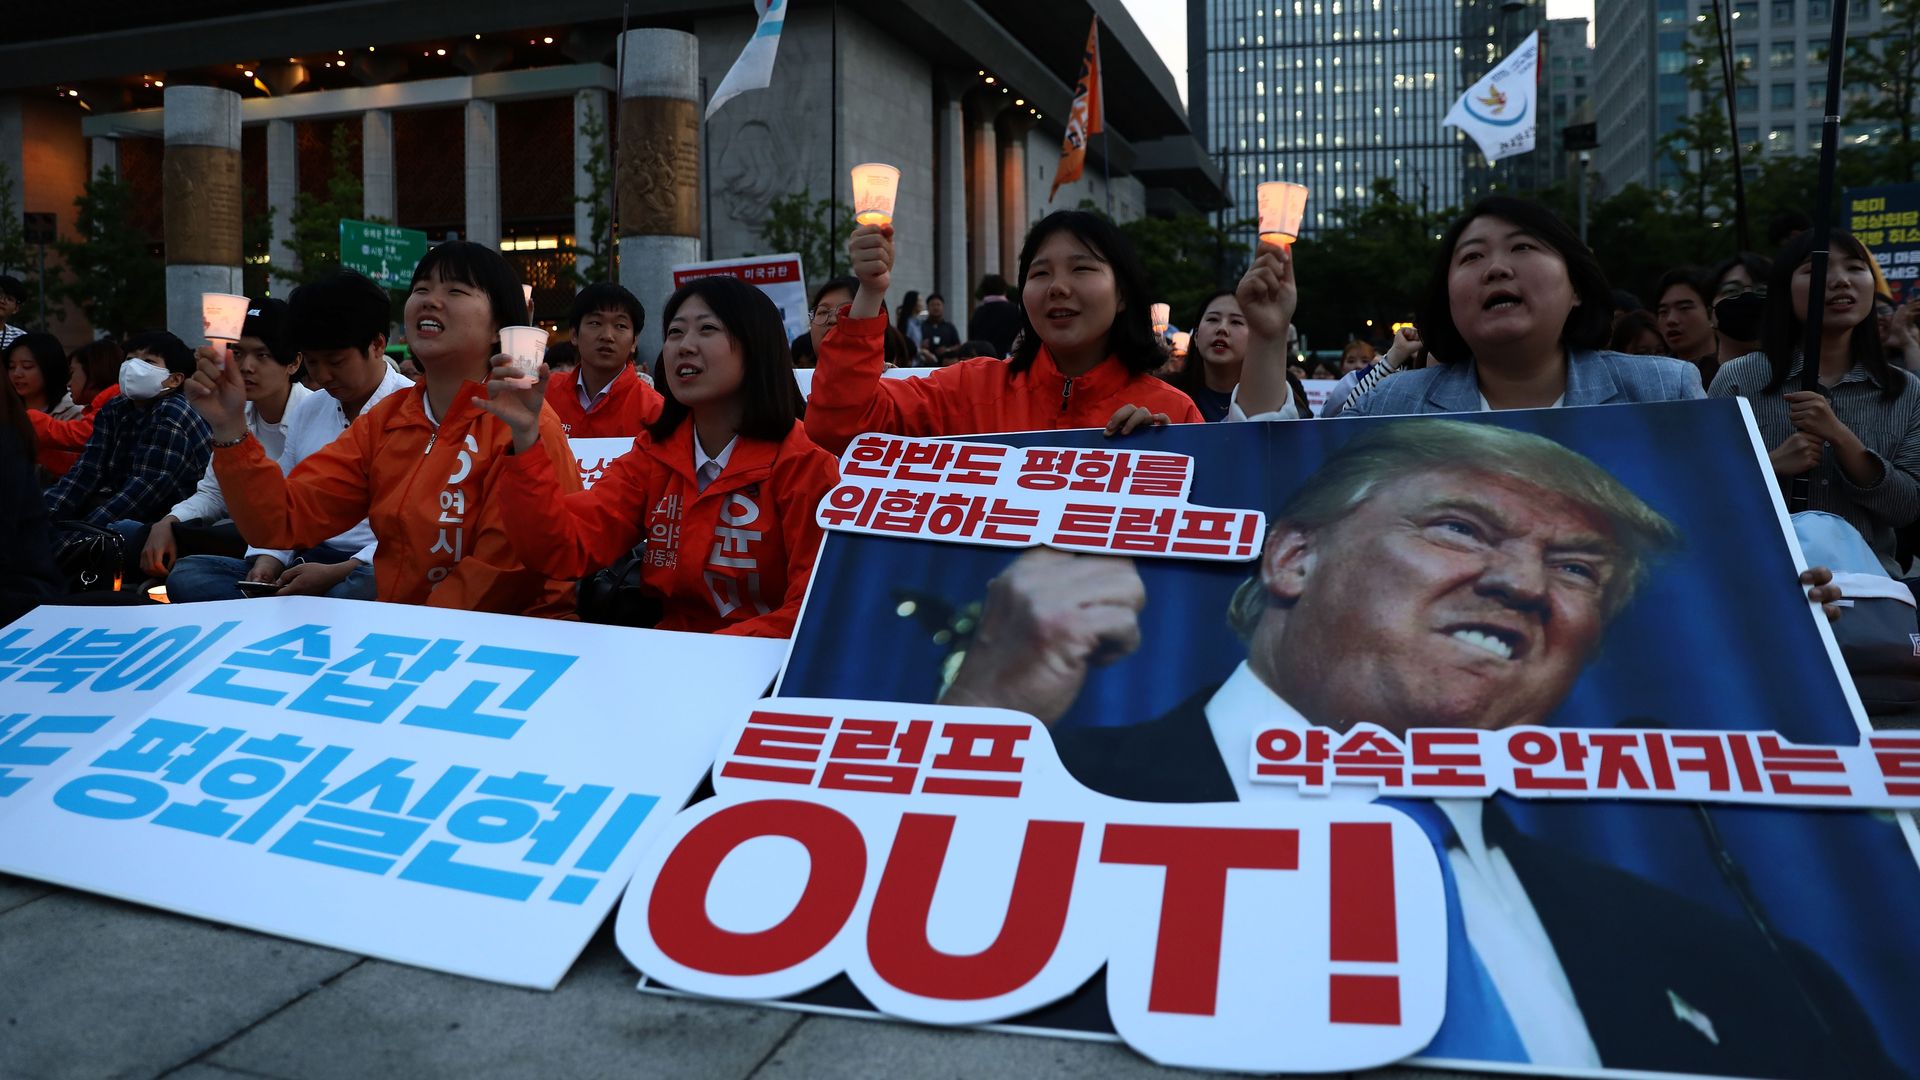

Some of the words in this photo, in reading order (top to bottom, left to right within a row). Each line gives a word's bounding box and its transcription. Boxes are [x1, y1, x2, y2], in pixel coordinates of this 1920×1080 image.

[843, 436, 1006, 486] 한반도
[1016, 450, 1190, 498] 평화를
[819, 485, 1041, 543] 위협하는
[1052, 502, 1259, 556] 트럼프!
[188, 623, 581, 740] 손잡고
[720, 711, 1032, 798] 트럼프
[1256, 729, 1486, 787] 약속도
[1507, 730, 1854, 797] 안지키는
[53, 717, 661, 906] 평화실현!
[647, 799, 1402, 1025] OUT!
